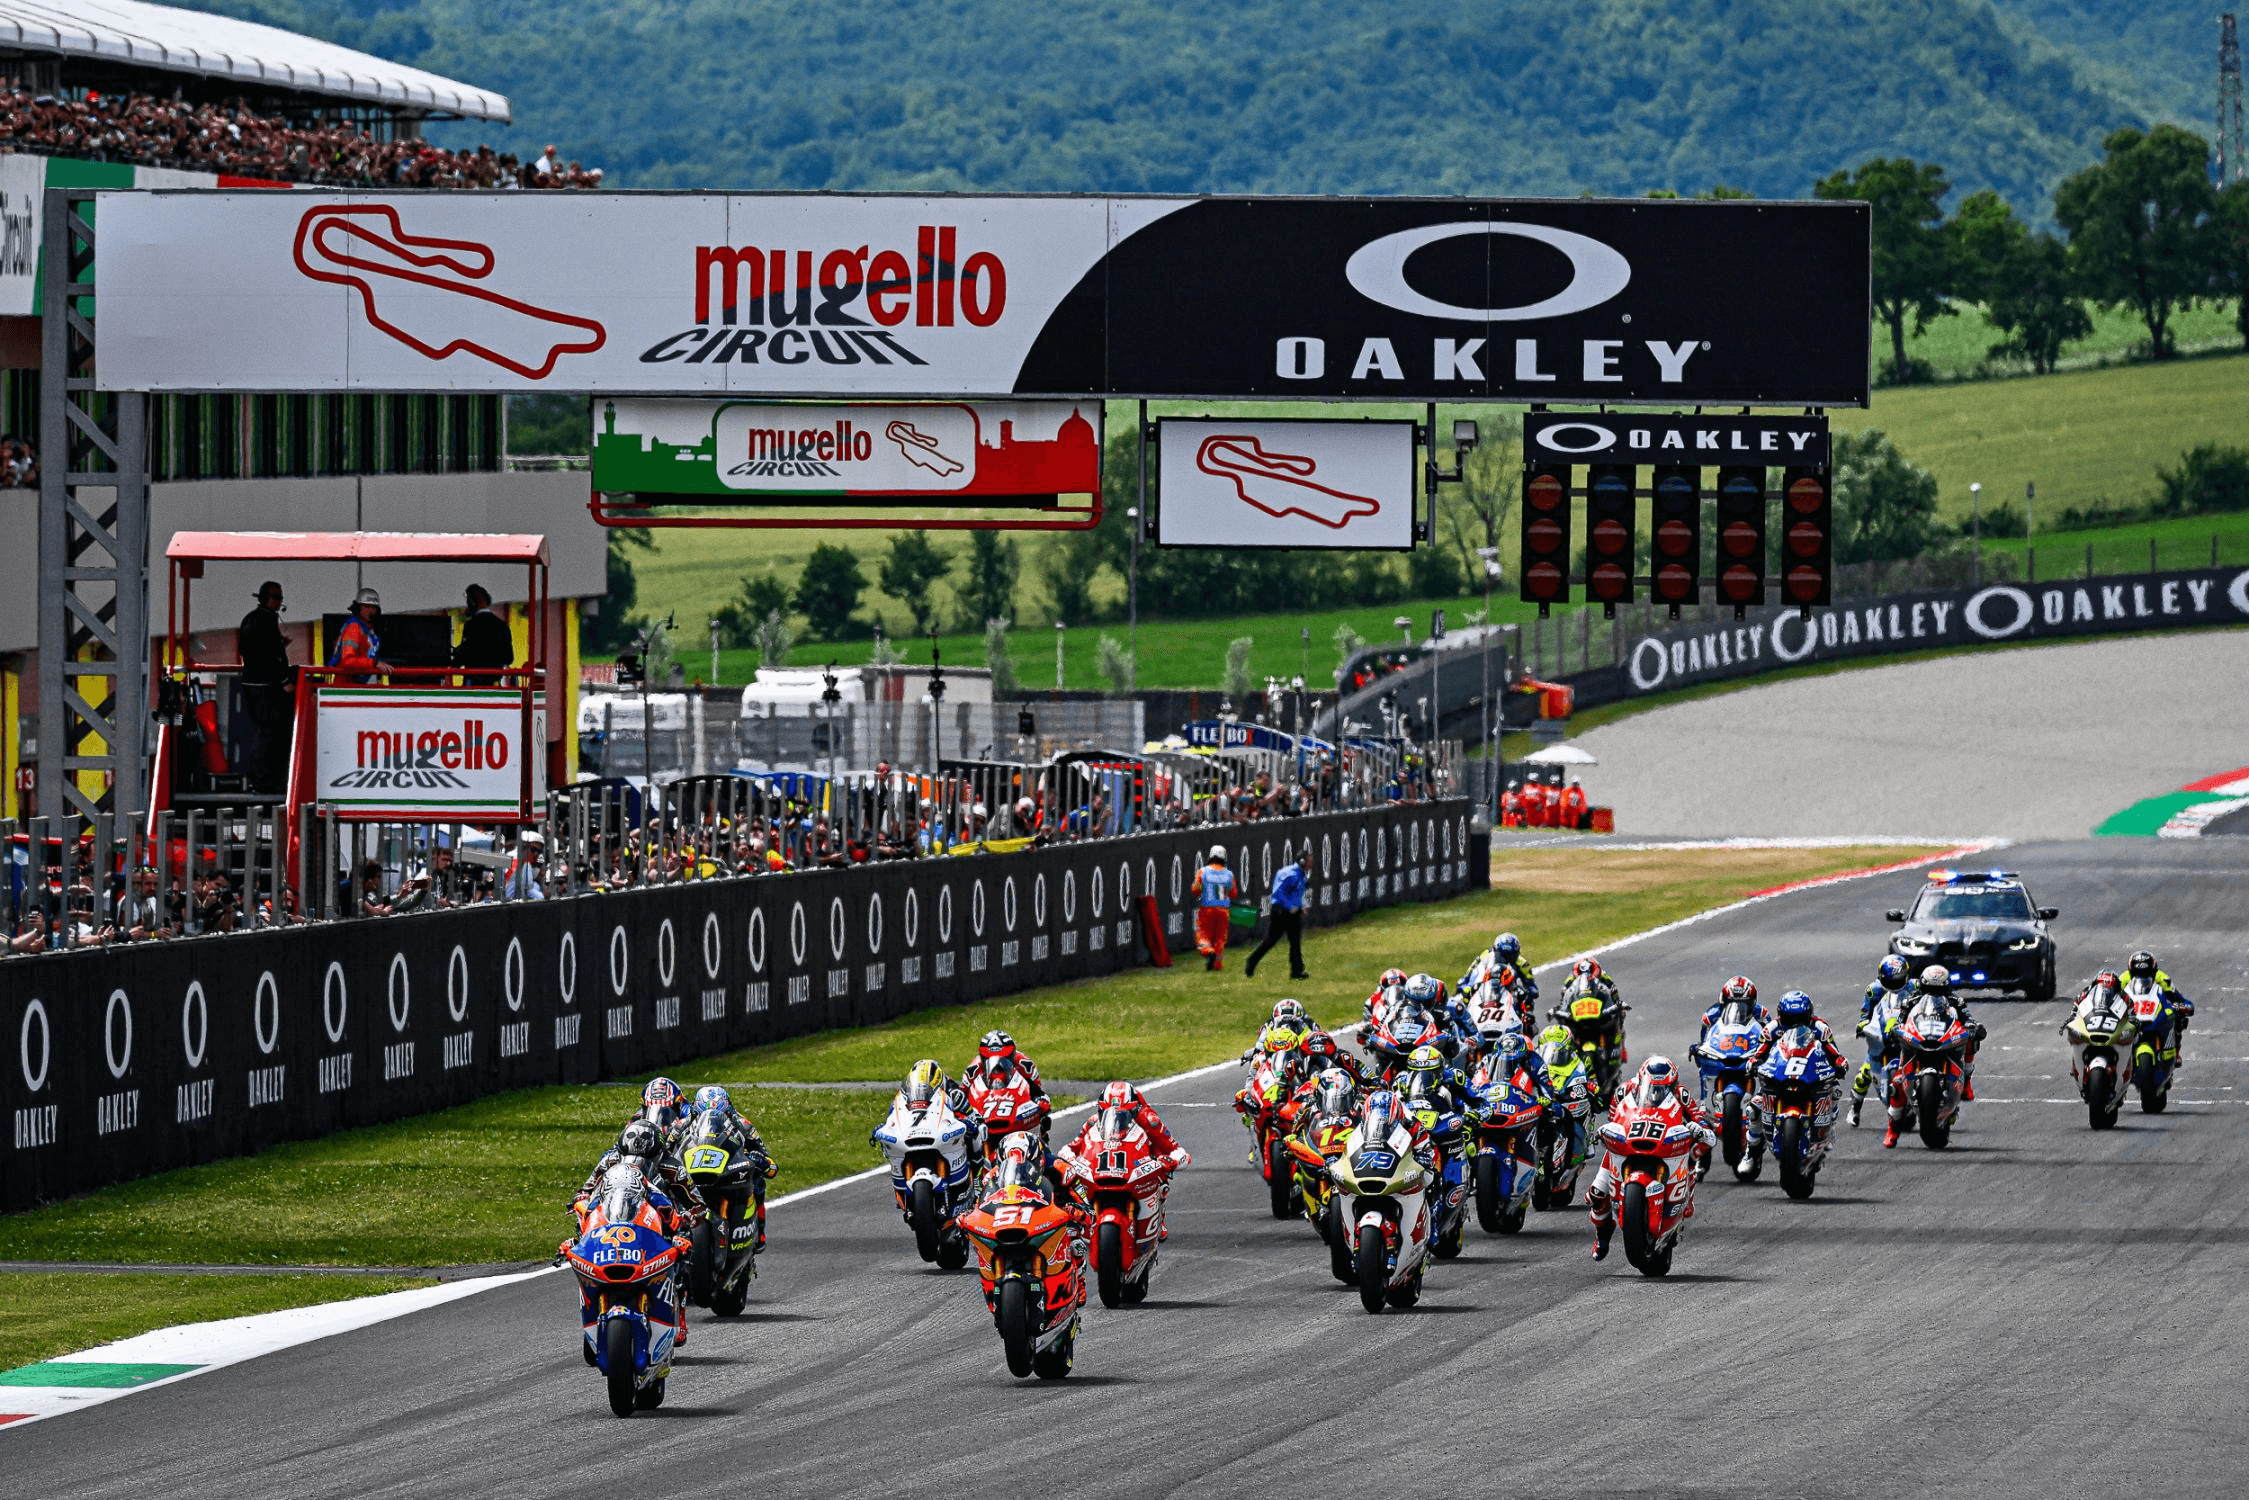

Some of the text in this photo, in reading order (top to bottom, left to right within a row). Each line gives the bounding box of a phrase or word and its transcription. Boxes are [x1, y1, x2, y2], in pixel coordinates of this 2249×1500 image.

[695, 225, 1007, 327] mugello
[639, 328, 930, 366] CIRCUIT
[748, 420, 872, 462] mugello
[1629, 429, 1812, 451] OAKLEY
[727, 461, 842, 477] CIRCUIT
[1665, 625, 1764, 675] OAKLEY
[1822, 601, 1954, 646] OAKLEY
[2043, 580, 2208, 624] OAKLEY
[357, 719, 509, 770] mugello
[329, 770, 471, 789] CIRCUIT
[1720, 1036, 1749, 1051] 64
[319, 1052, 352, 1094] OAKLEY
[1784, 1056, 1809, 1076] 6
[248, 1065, 285, 1108] OAKLEY
[177, 1078, 214, 1123] OAKLEY
[983, 1100, 1015, 1119] 75
[98, 1089, 139, 1136] OAKLEY
[911, 1109, 928, 1128] 7
[15, 1104, 58, 1149] OAKLEY
[1628, 1120, 1666, 1141] 96
[691, 1148, 725, 1169] 13
[1096, 1149, 1129, 1174] 11
[1353, 1150, 1397, 1172] 79
[991, 1205, 1036, 1228] 51
[571, 1256, 597, 1277] STIHL
[642, 1253, 671, 1276] STIHL
